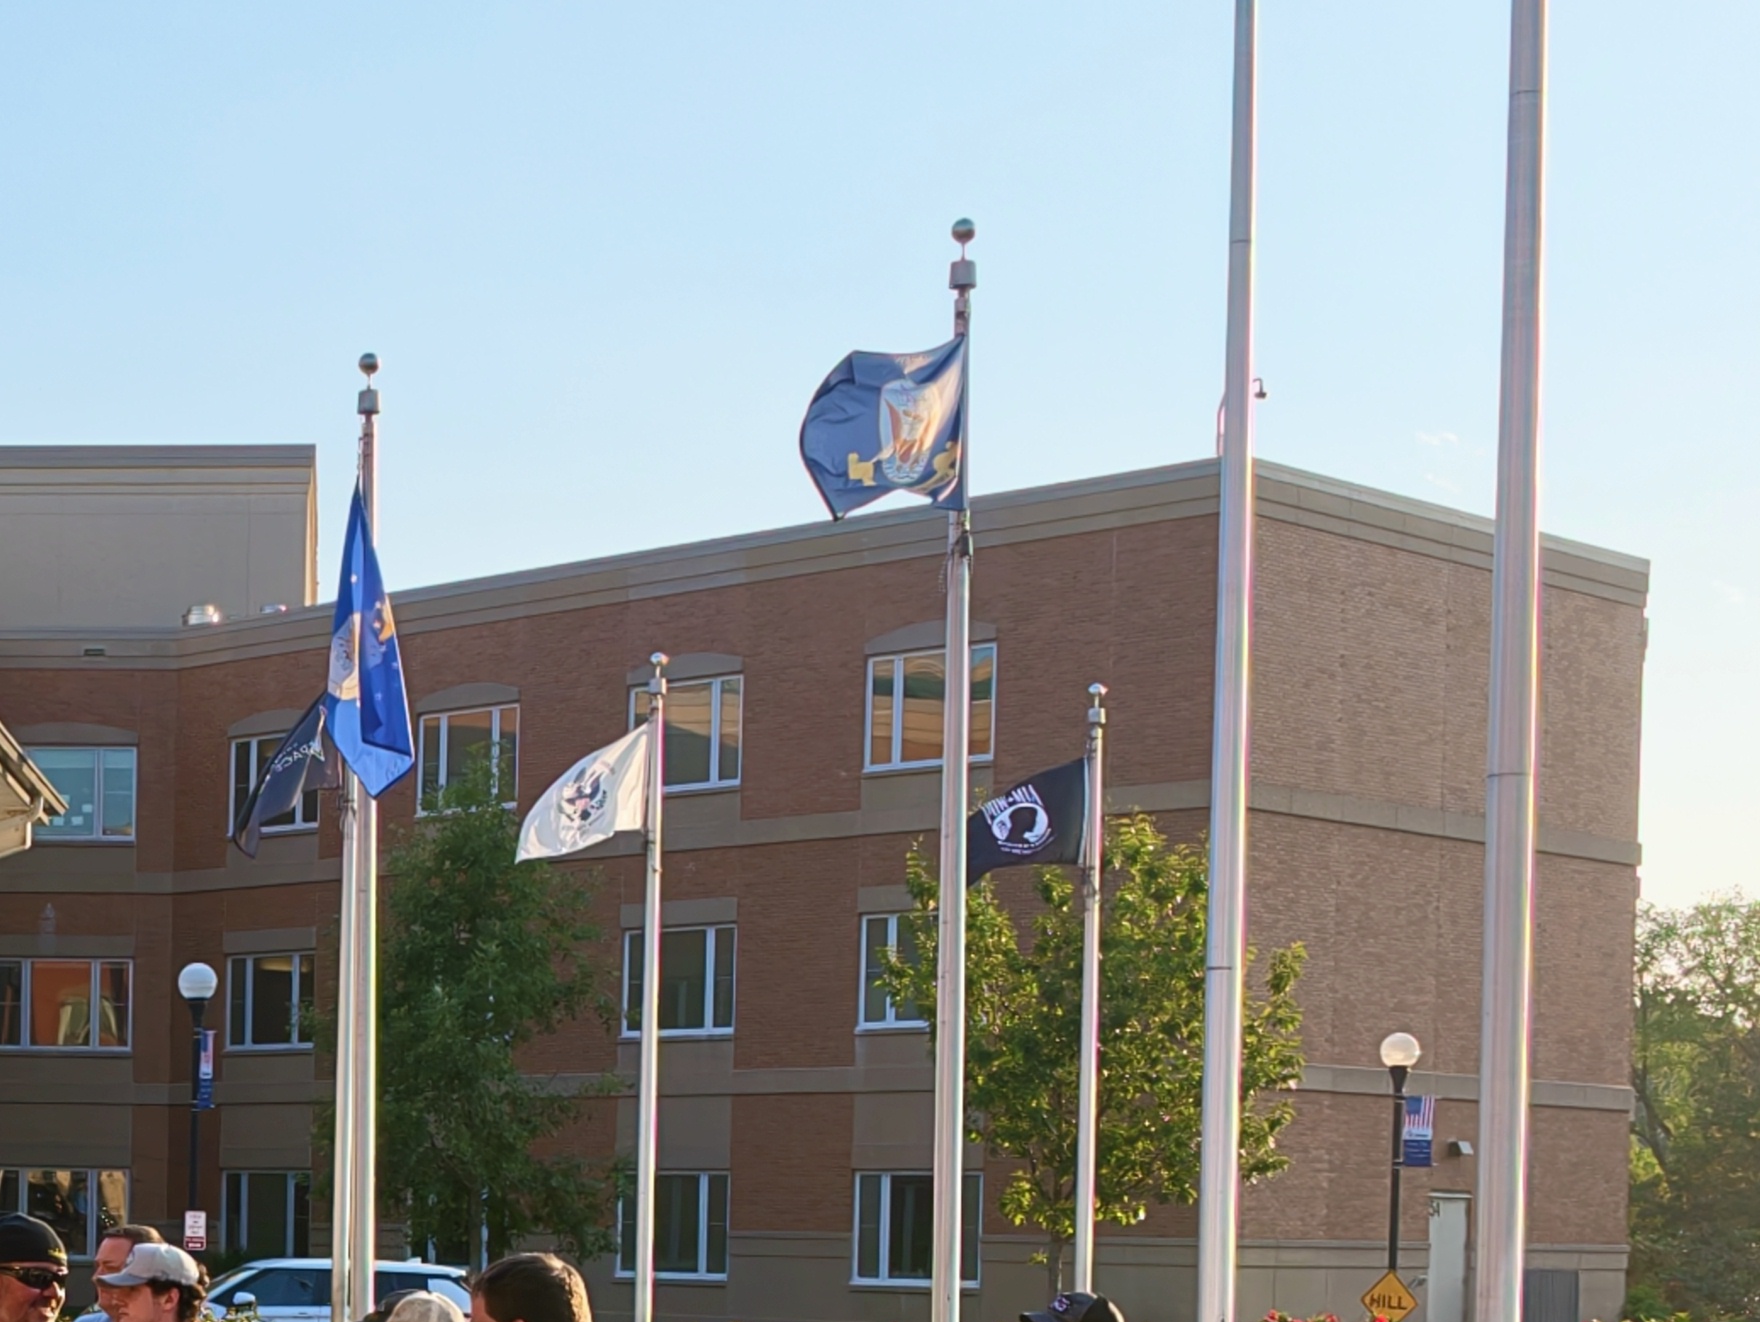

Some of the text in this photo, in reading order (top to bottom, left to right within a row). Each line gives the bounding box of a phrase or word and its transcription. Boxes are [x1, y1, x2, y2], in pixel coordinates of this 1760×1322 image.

[981, 784, 1044, 826] POW MIA
[1369, 1293, 1408, 1310] HILL
